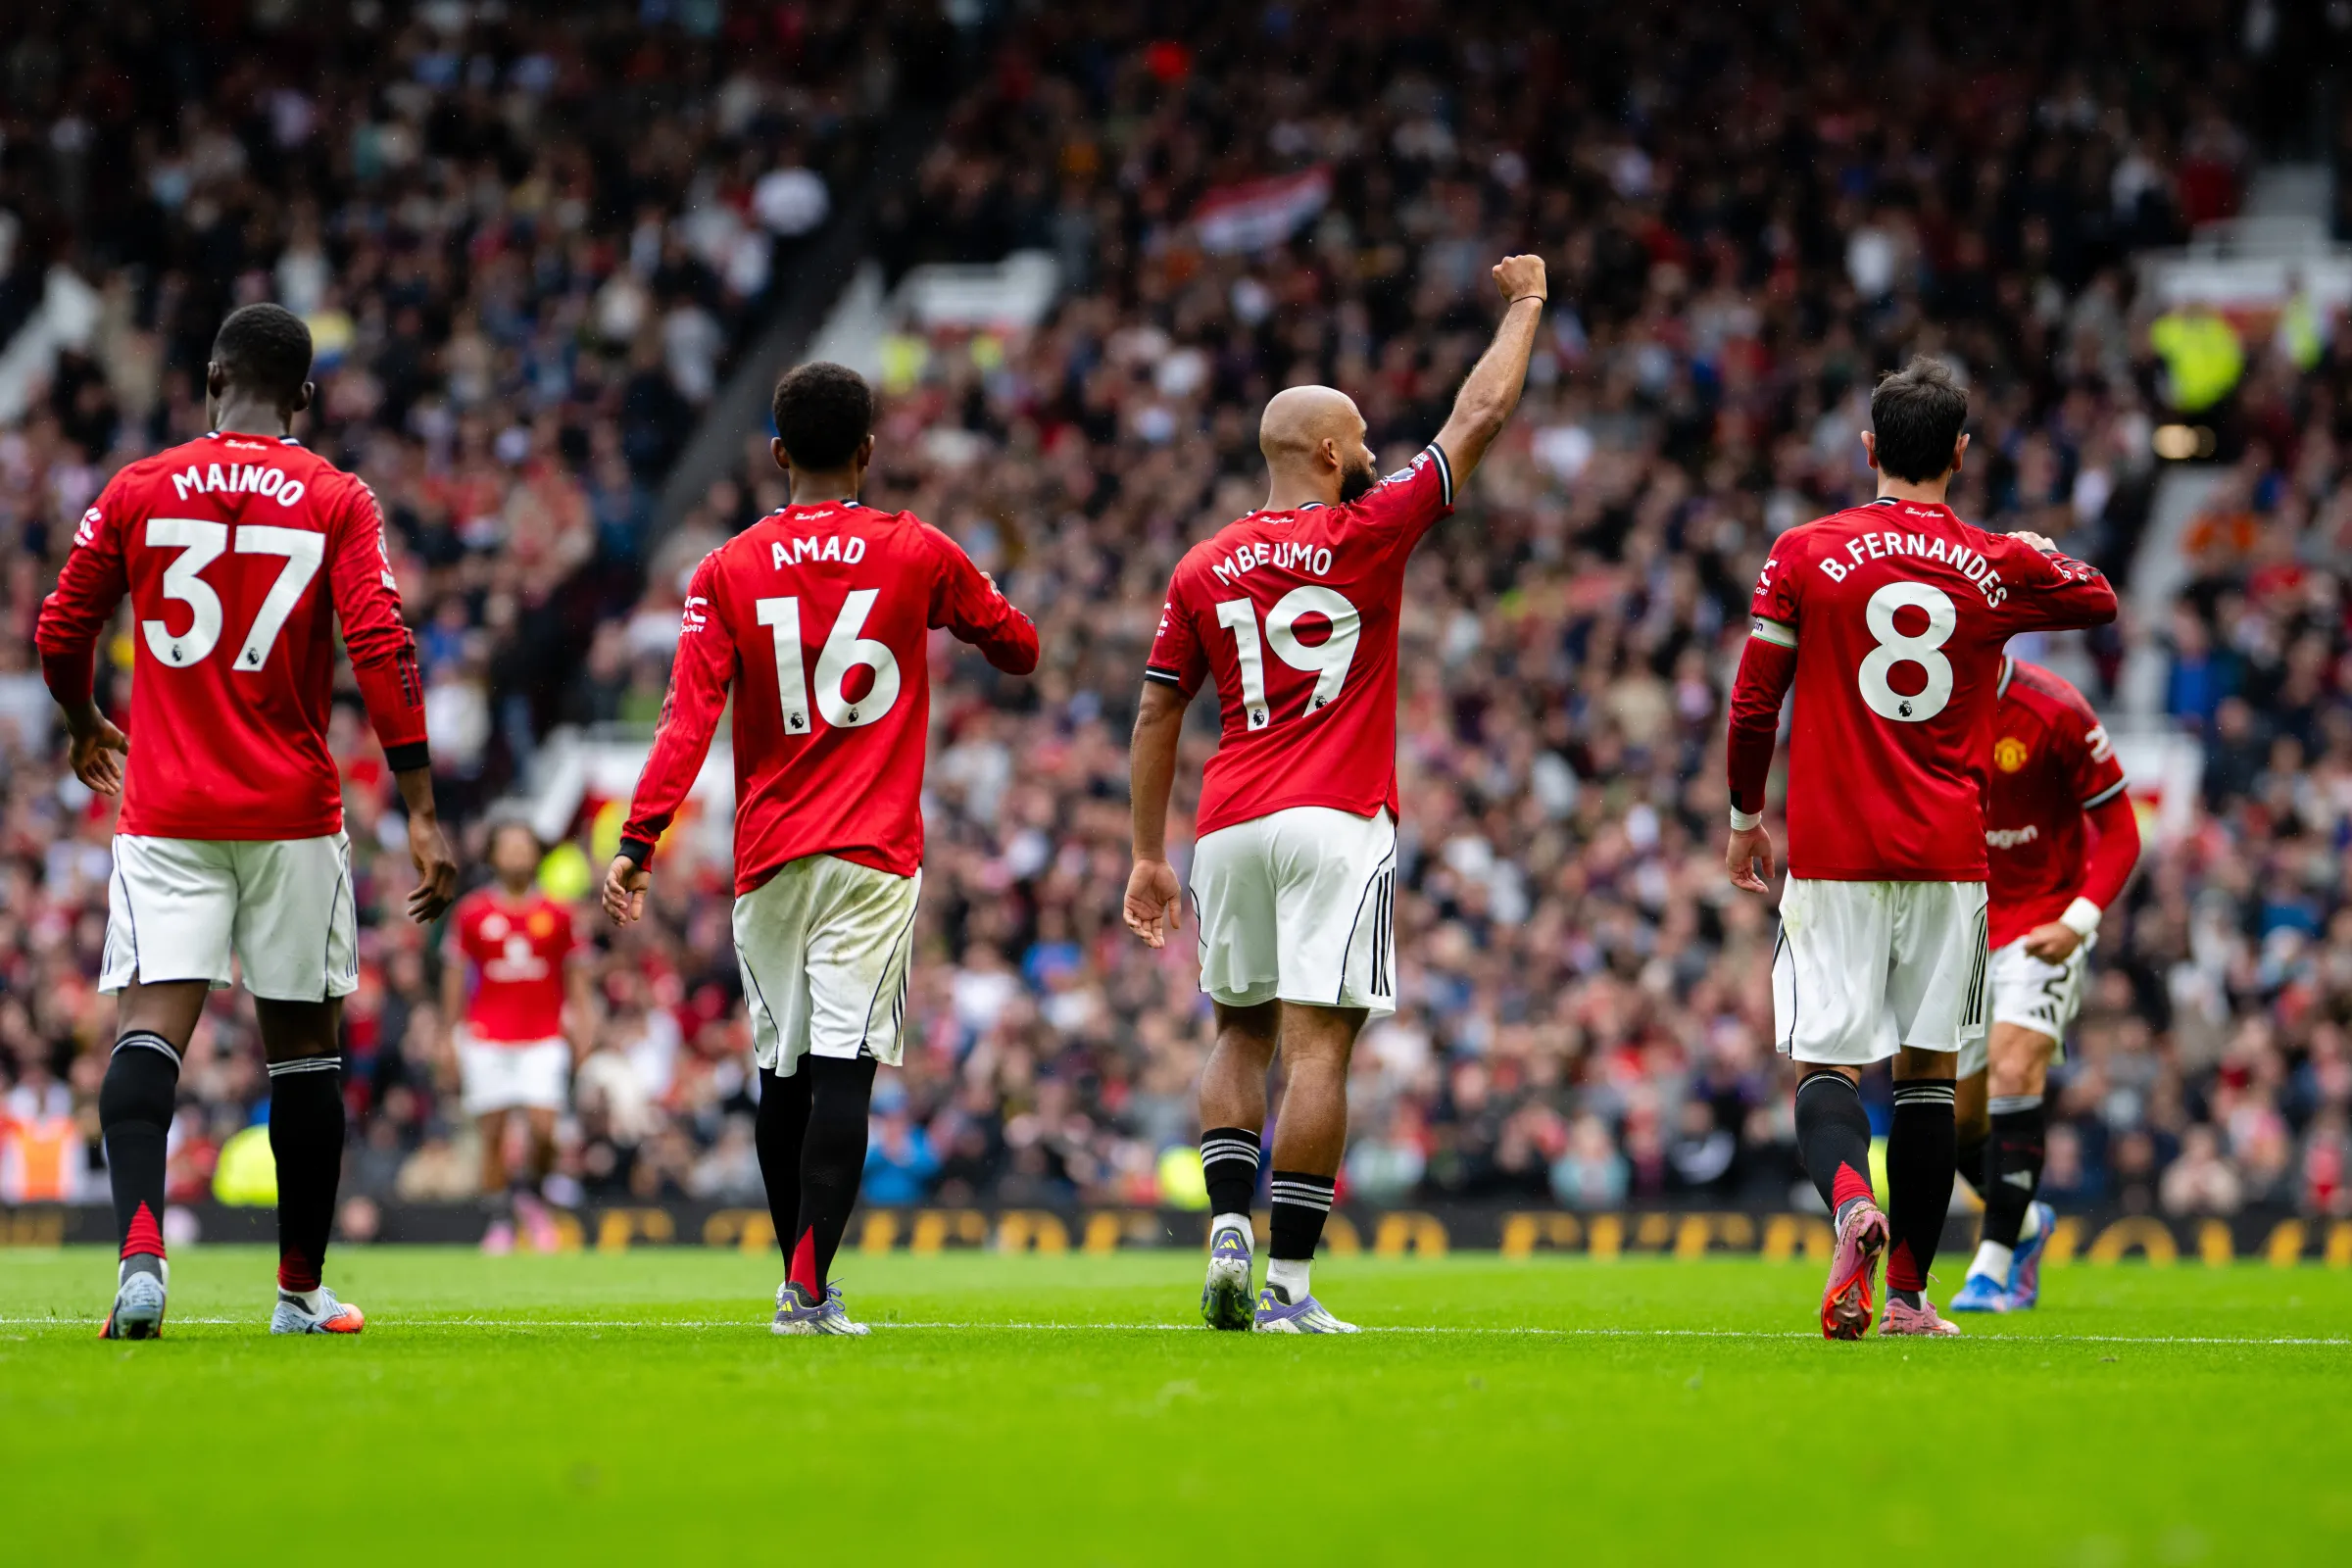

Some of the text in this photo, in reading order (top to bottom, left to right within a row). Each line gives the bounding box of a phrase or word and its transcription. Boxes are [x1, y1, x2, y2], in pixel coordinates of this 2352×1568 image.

[172, 463, 305, 507] MAINOO
[142, 517, 325, 671] 37
[771, 535, 866, 570] AMAD
[1211, 542, 1332, 587] MBEUMO
[1818, 531, 2008, 609] B.FERNANDES
[756, 588, 901, 735] 16
[1216, 585, 1361, 732] 19
[1858, 581, 1957, 722] 8
